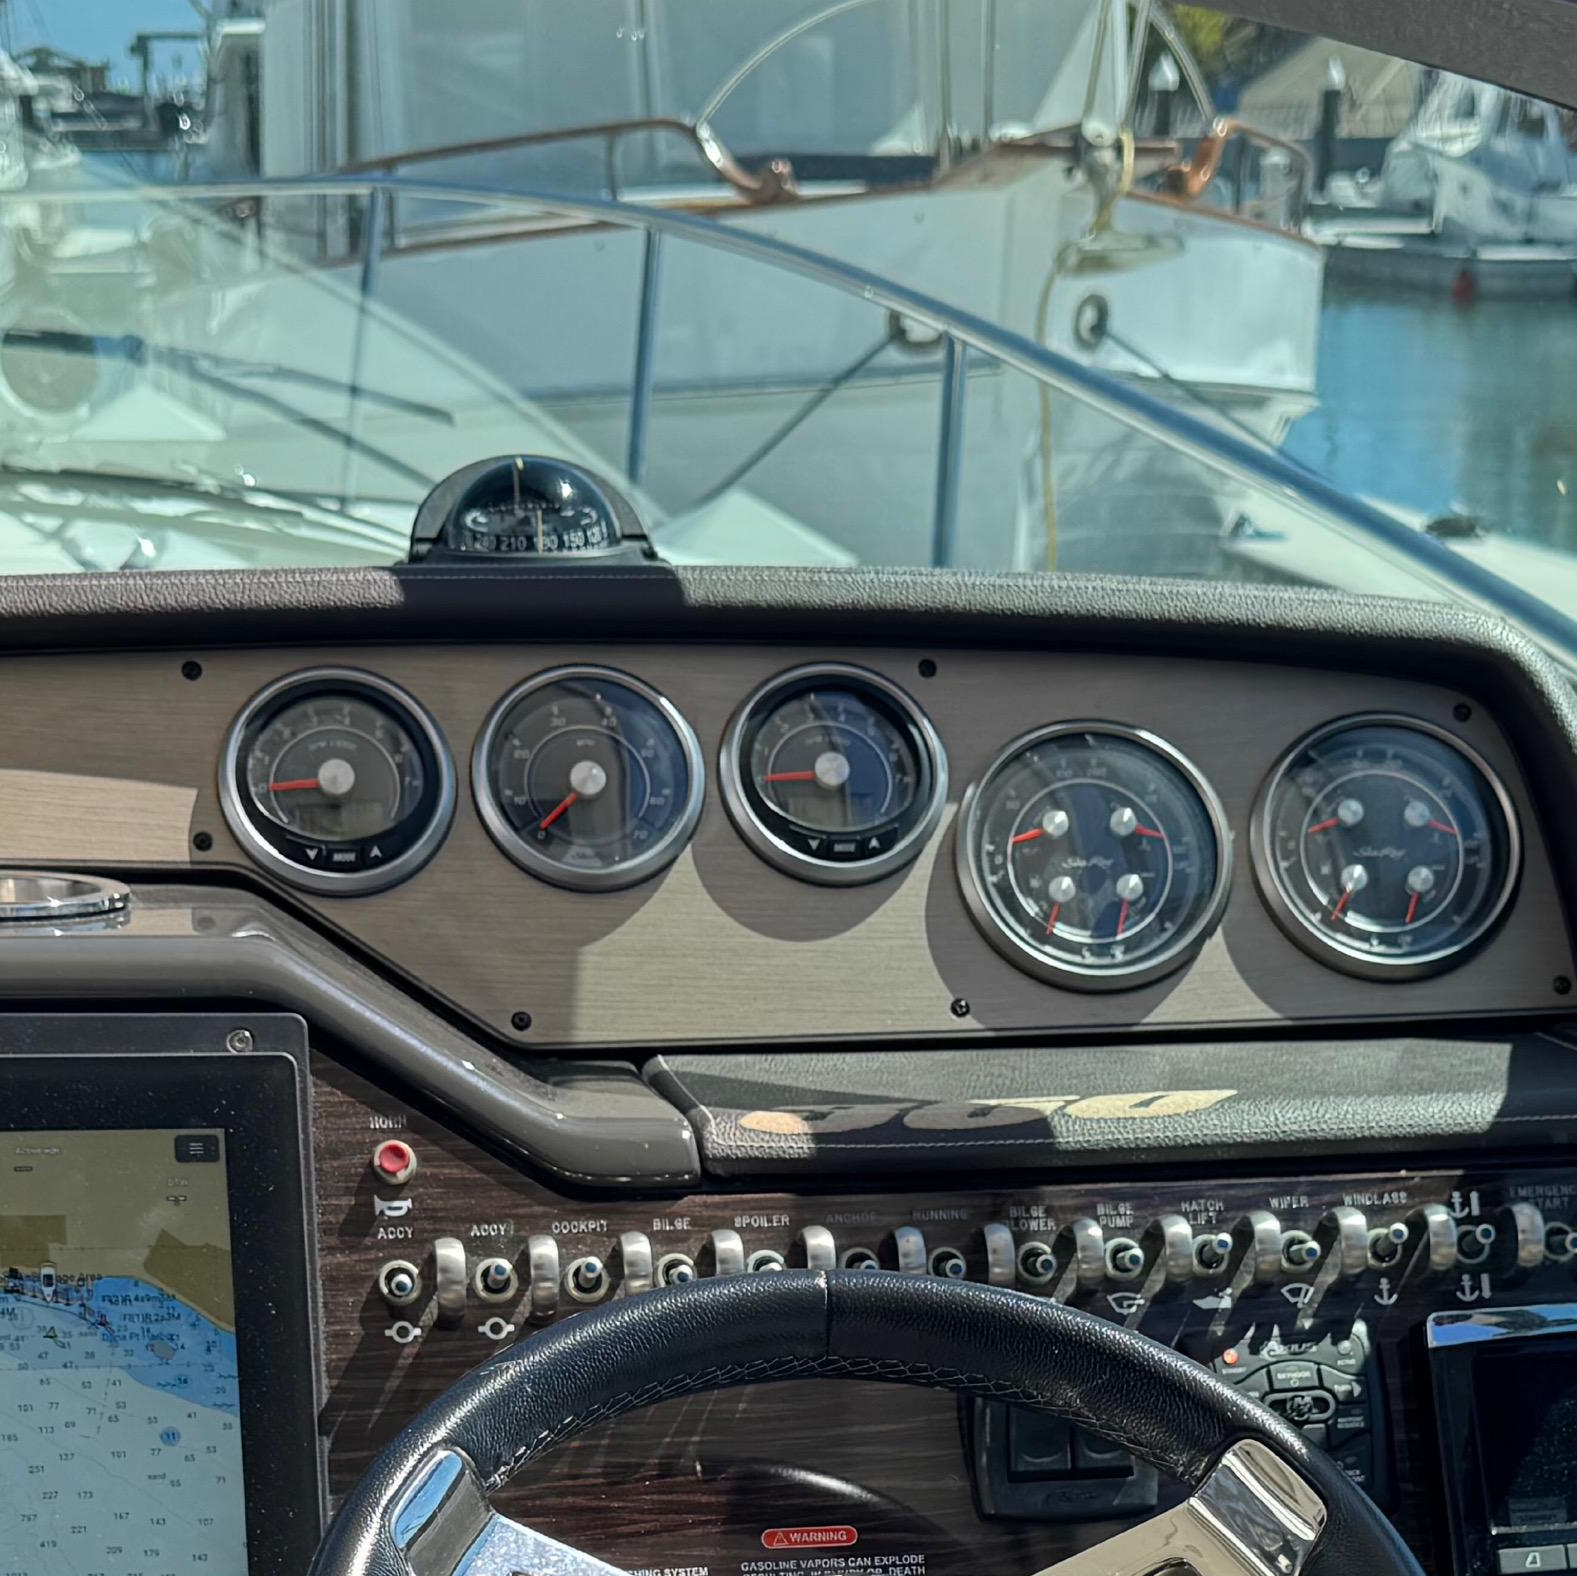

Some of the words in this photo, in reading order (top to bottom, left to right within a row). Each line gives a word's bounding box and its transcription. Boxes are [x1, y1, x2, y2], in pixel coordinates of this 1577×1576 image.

[500, 536, 525, 550] 210
[1269, 1195, 1309, 1209] WIPER
[1342, 1191, 1409, 1205] WINDLASS
[1009, 1206, 1047, 1217] BILGE
[1097, 1203, 1135, 1215] BILGE
[1181, 1200, 1225, 1212] HATCH
[653, 1217, 692, 1231] BILGE
[734, 1215, 790, 1228] SPOILER
[1099, 1215, 1135, 1228] PUMP
[1189, 1212, 1217, 1225] LIFT
[470, 1224, 506, 1237] ACCY
[552, 1220, 608, 1234] COCKPIT
[377, 1228, 414, 1240] ACCY
[790, 1530, 847, 1543] WARNING
[741, 1559, 798, 1572] GASOLINE
[799, 1557, 846, 1570] VAPORS
[848, 1556, 873, 1567] CAN
[874, 1554, 925, 1566] EXPLODE
